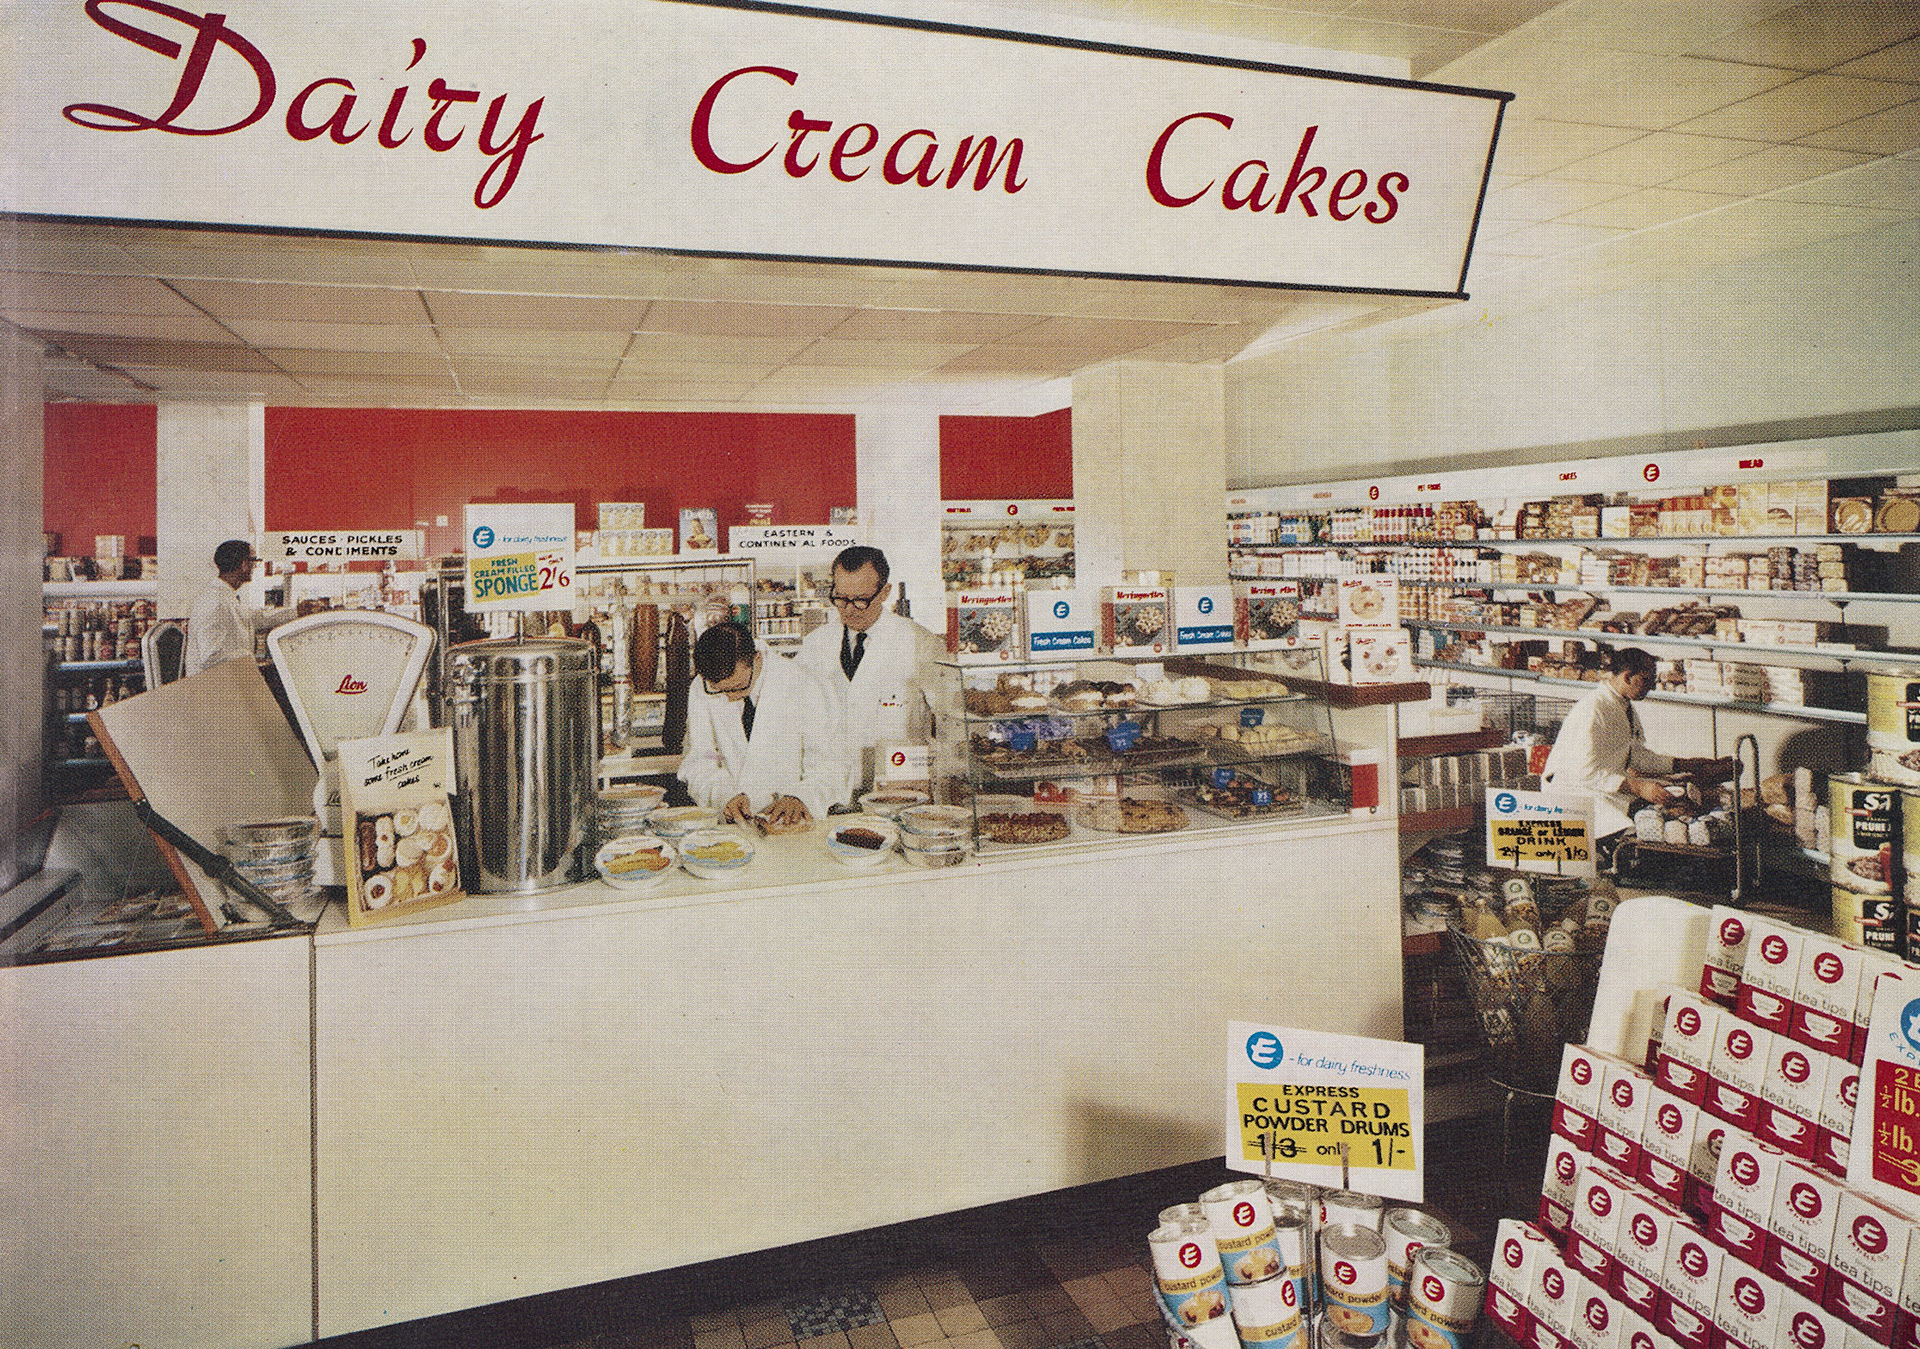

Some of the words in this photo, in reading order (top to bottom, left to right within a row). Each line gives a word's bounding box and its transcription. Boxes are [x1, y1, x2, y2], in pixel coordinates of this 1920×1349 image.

[62, 0, 547, 208] Dairy
[691, 65, 1028, 195] Cream
[1146, 112, 1409, 225] Cakes
[282, 535, 337, 545] SAUCES
[347, 535, 403, 544] PICKLES
[739, 540, 815, 548] CONTINENAL
[764, 529, 815, 537] EASTERN
[474, 568, 505, 578] CREAM
[507, 564, 536, 574] FILLED
[491, 558, 518, 567] FRESH
[474, 573, 539, 598] SPONGE
[334, 674, 368, 694] Lion
[367, 754, 390, 770] Take
[385, 763, 408, 780] fresh
[410, 755, 434, 768] cream
[1516, 837, 1566, 846] DRINK
[1745, 972, 1763, 987] tea
[1767, 978, 1790, 996] tips
[1797, 990, 1818, 1005] tea
[1822, 998, 1847, 1016] tips
[1857, 1012, 1870, 1026] te
[1663, 1042, 1679, 1056] tea
[1681, 1049, 1702, 1067] tips
[1315, 1056, 1348, 1075] dairy
[1350, 1060, 1411, 1080] freshness
[1711, 1065, 1729, 1082] tea
[1732, 1073, 1755, 1093] tips
[1283, 1084, 1360, 1098] EXPRESS
[1253, 1097, 1391, 1119] CUSTARD
[1763, 1089, 1784, 1106] tea
[1787, 1098, 1812, 1118] tips
[1244, 1114, 1329, 1133] POWDER
[1340, 1120, 1410, 1137] DRUMS
[1822, 1113, 1844, 1131] tea
[1316, 1141, 1345, 1156] onl
[1644, 1139, 1661, 1155] tea
[1664, 1147, 1685, 1167] tips
[1714, 1188, 1734, 1207] tea
[1737, 1198, 1762, 1224] tips
[1574, 1220, 1590, 1237] tea
[1593, 1229, 1614, 1250] tips
[1773, 1219, 1795, 1242] tea
[1799, 1233, 1826, 1260] tips
[1617, 1248, 1635, 1266] tea
[1638, 1258, 1660, 1282] tips
[1834, 1253, 1858, 1276] tea
[1863, 1267, 1893, 1298] tips
[1665, 1278, 1683, 1298] tea
[1687, 1288, 1711, 1317] tips
[1265, 1319, 1297, 1337] custard
[1529, 1302, 1545, 1320] tea
[1547, 1312, 1566, 1334] tips
[1717, 1315, 1739, 1339] tea
